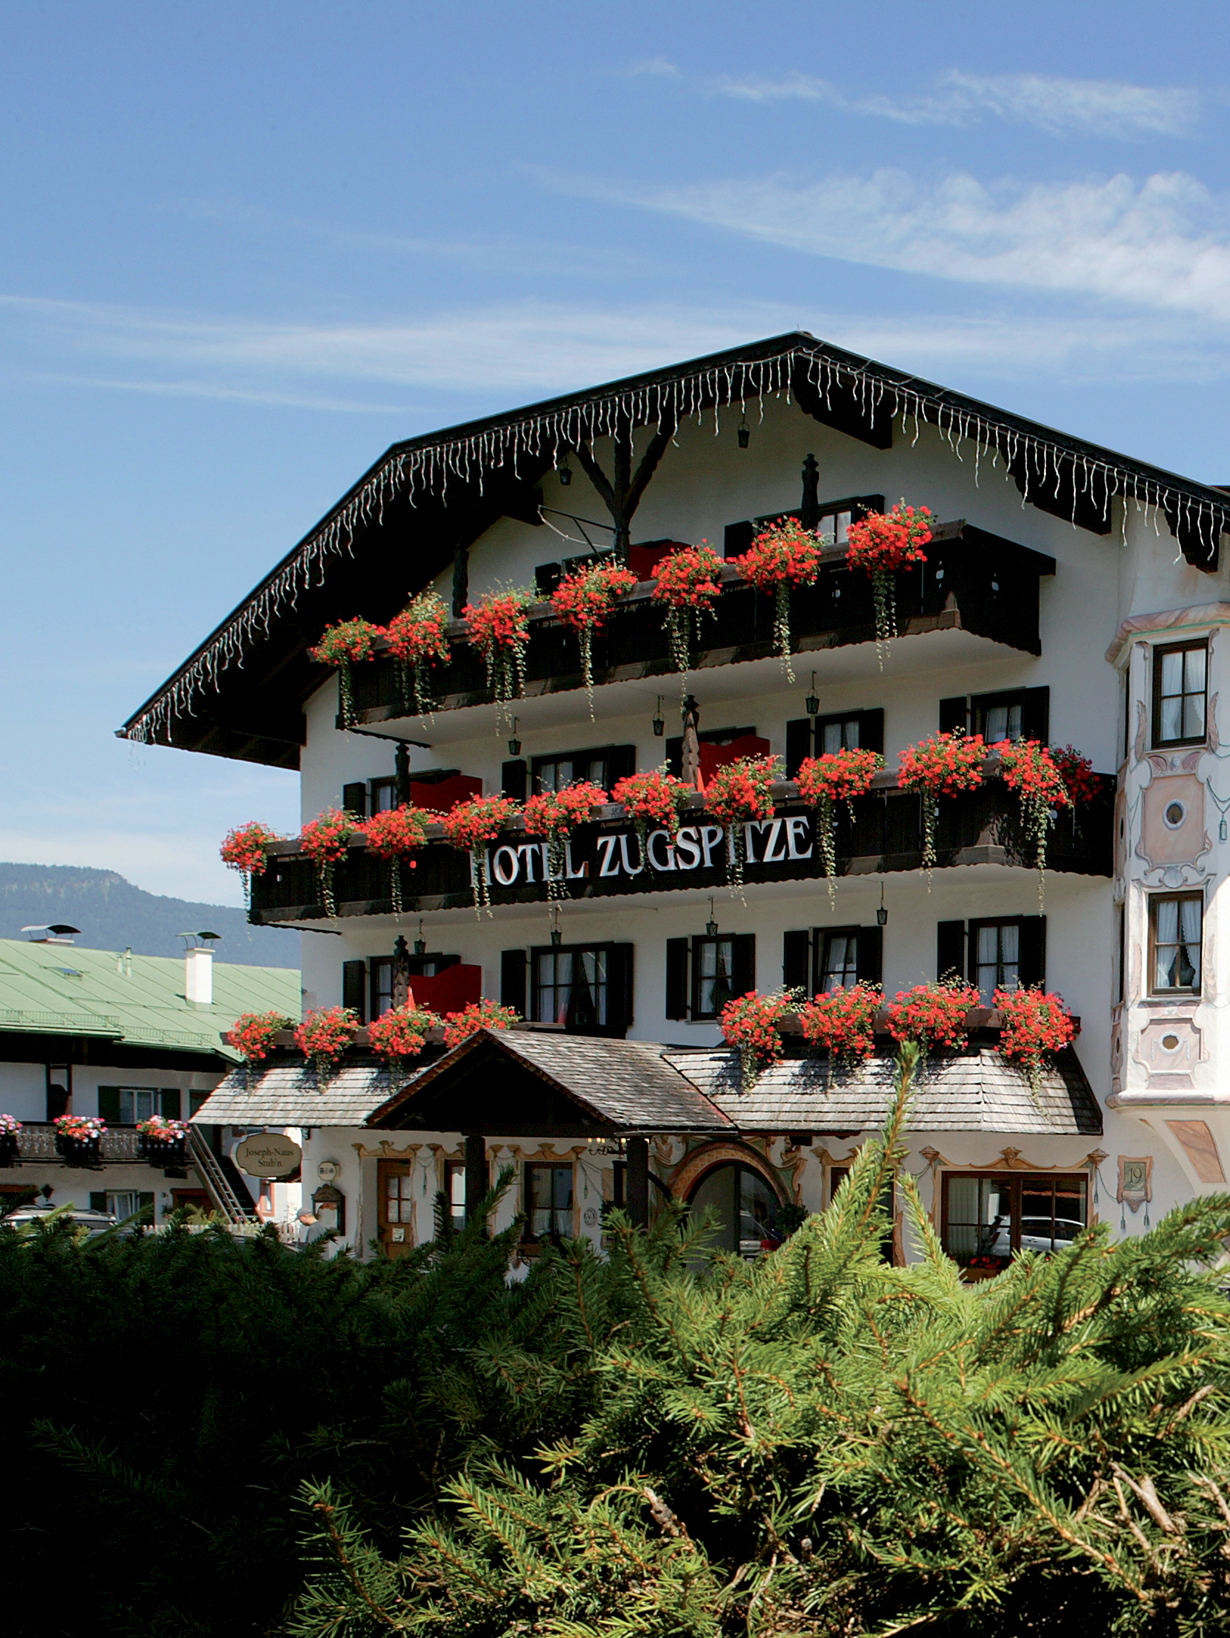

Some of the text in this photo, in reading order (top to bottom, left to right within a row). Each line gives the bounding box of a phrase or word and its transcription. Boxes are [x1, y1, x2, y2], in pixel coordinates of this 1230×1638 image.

[469, 815, 814, 888] HOTEL ZUGSPITZE
[1129, 1166, 1143, 1184] 19
